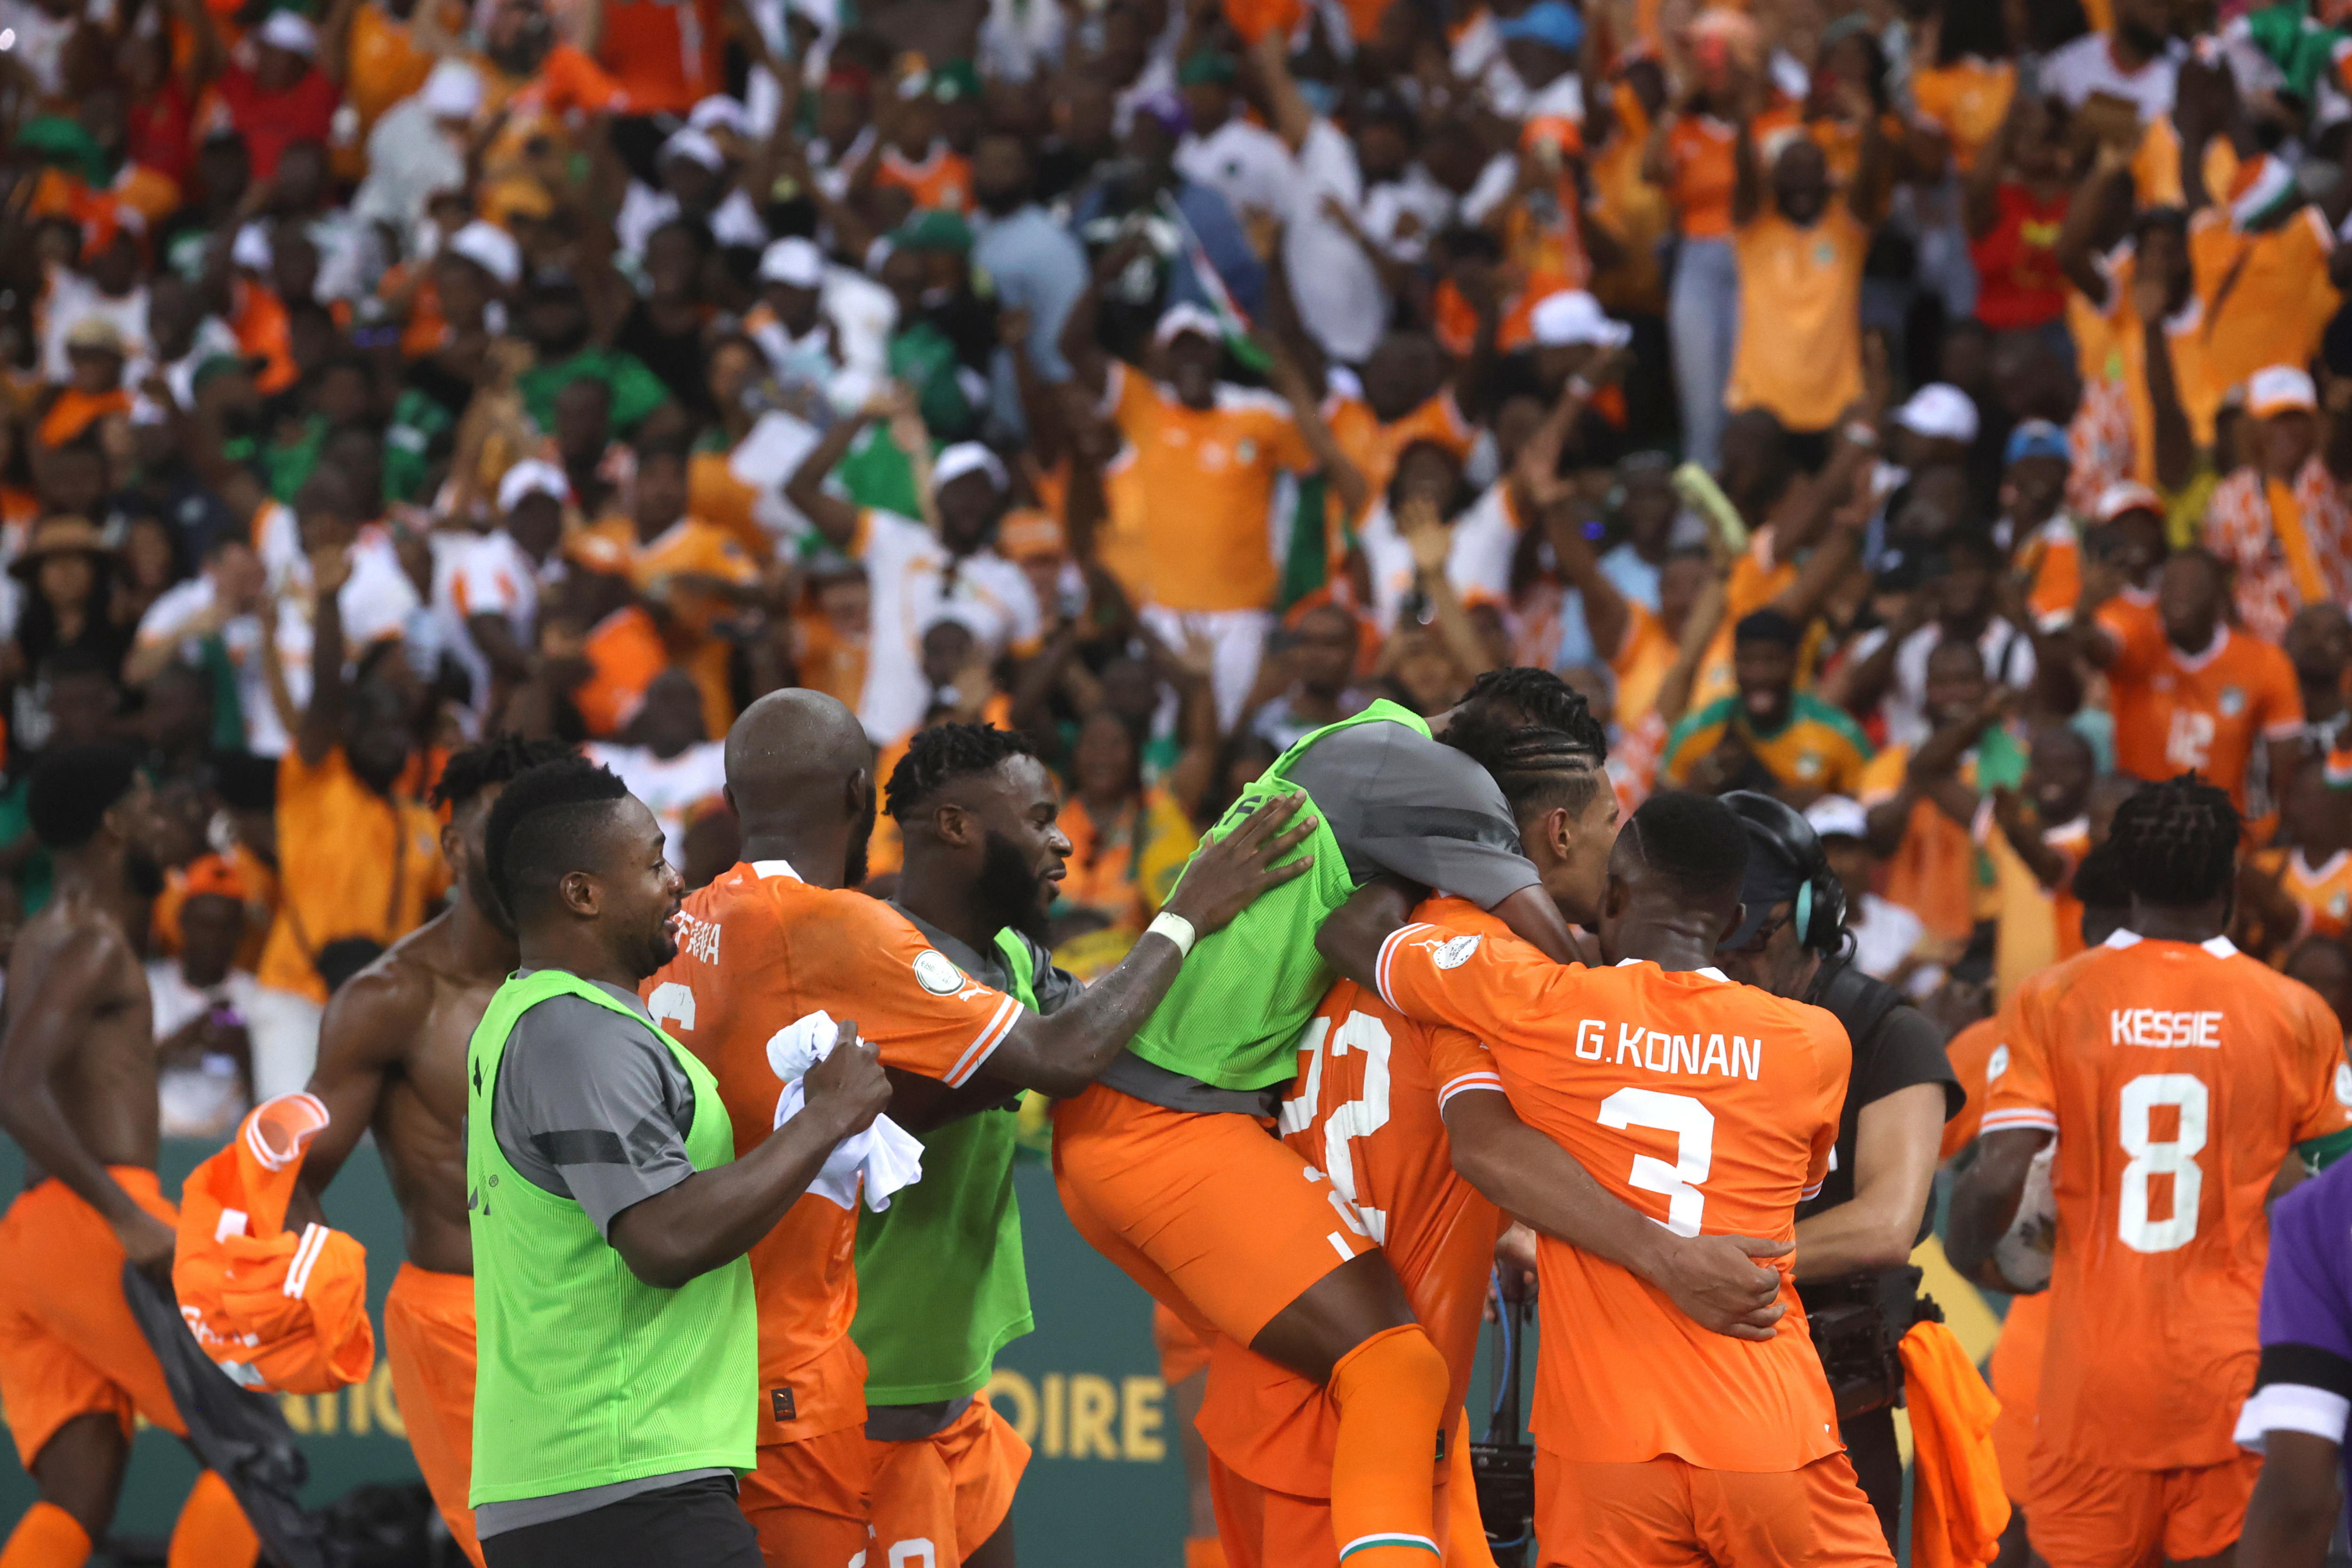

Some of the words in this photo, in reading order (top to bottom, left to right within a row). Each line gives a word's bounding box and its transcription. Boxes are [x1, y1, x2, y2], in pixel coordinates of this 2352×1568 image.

[1575, 1019, 1762, 1081] G.KONAN
[2111, 1008, 2224, 1049] KESSIE
[1597, 1087, 1715, 1237] 3
[2118, 1073, 2209, 1254] 8
